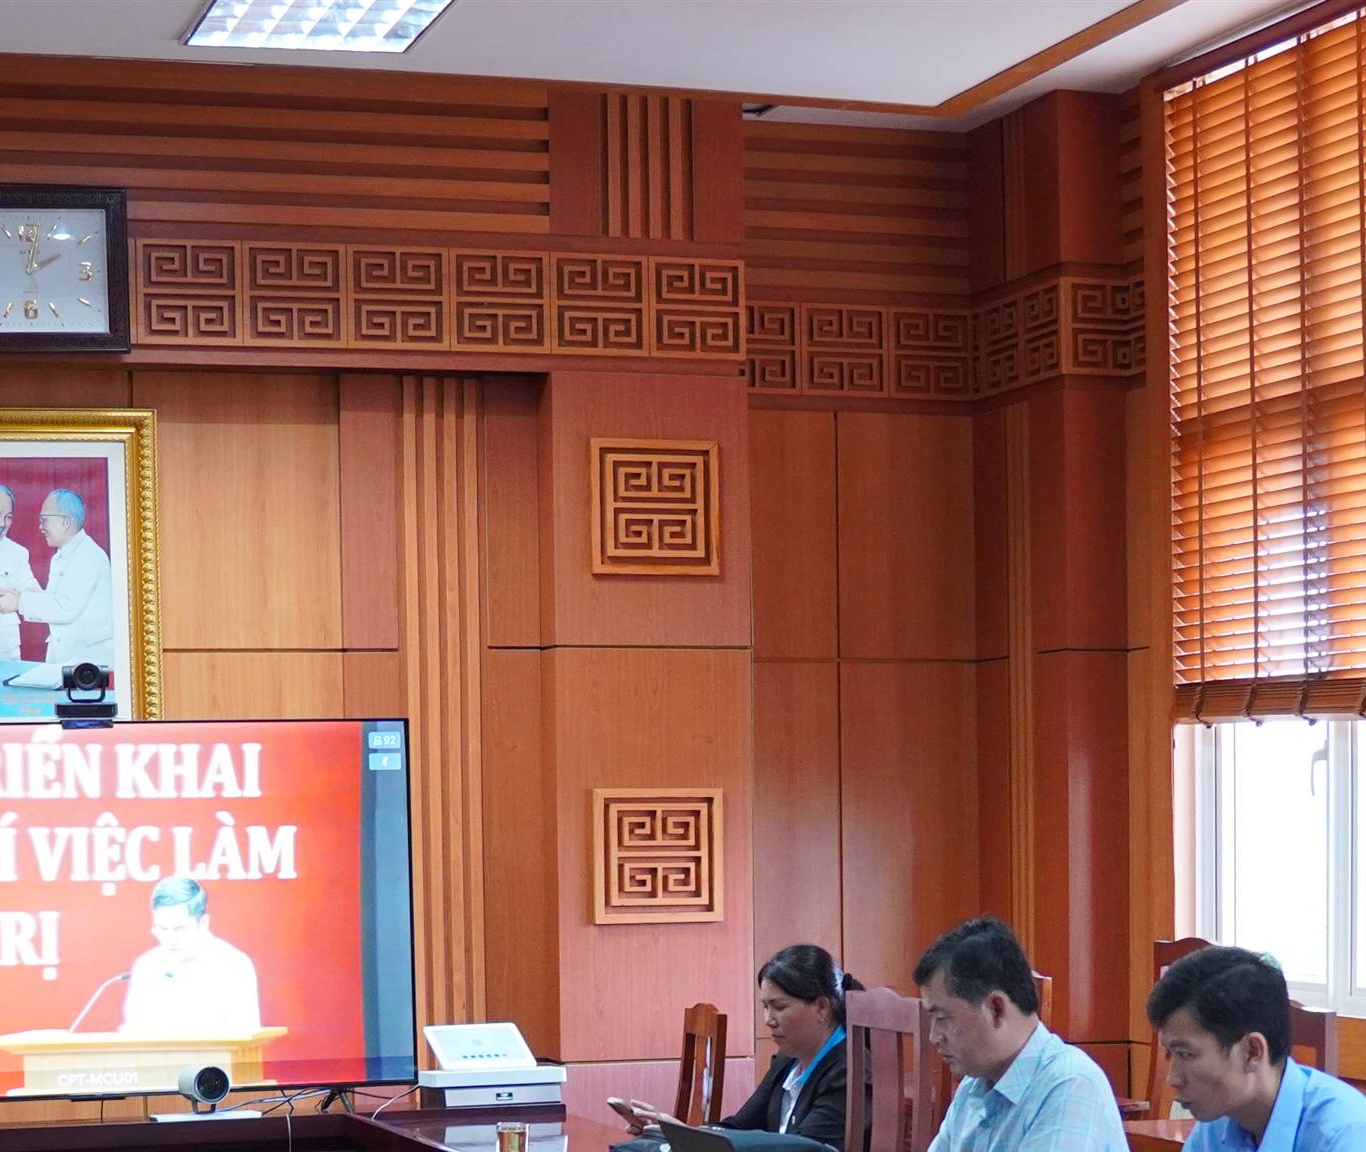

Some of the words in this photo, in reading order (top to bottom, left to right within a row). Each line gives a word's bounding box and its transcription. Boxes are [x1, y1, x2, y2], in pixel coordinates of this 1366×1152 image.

[78, 261, 92, 281] 3
[23, 299, 39, 320] 6
[116, 741, 262, 799] KHAI
[28, 812, 160, 897] VIỆC
[172, 811, 296, 880] LÀM
